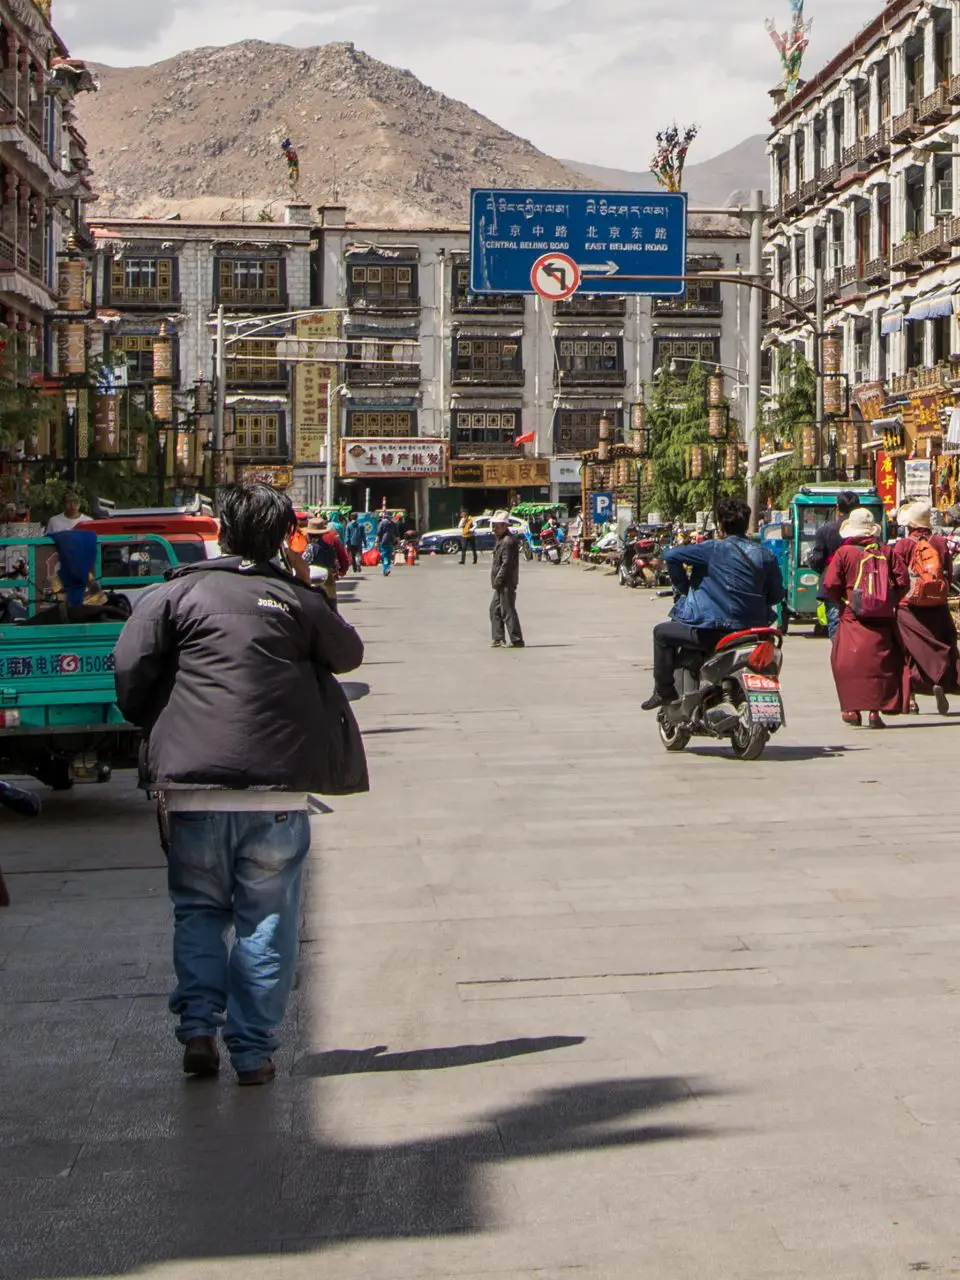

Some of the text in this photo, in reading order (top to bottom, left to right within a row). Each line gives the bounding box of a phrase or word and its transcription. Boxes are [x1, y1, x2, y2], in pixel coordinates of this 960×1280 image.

[486, 224, 568, 238] 北京中路
[586, 225, 667, 240] 北京东路
[485, 241, 570, 250] CENTRAL BEIJING ROAD
[585, 242, 668, 252] EAST BEIJING ROAD
[365, 453, 439, 466] 土特产批发
[597, 496, 610, 514] P
